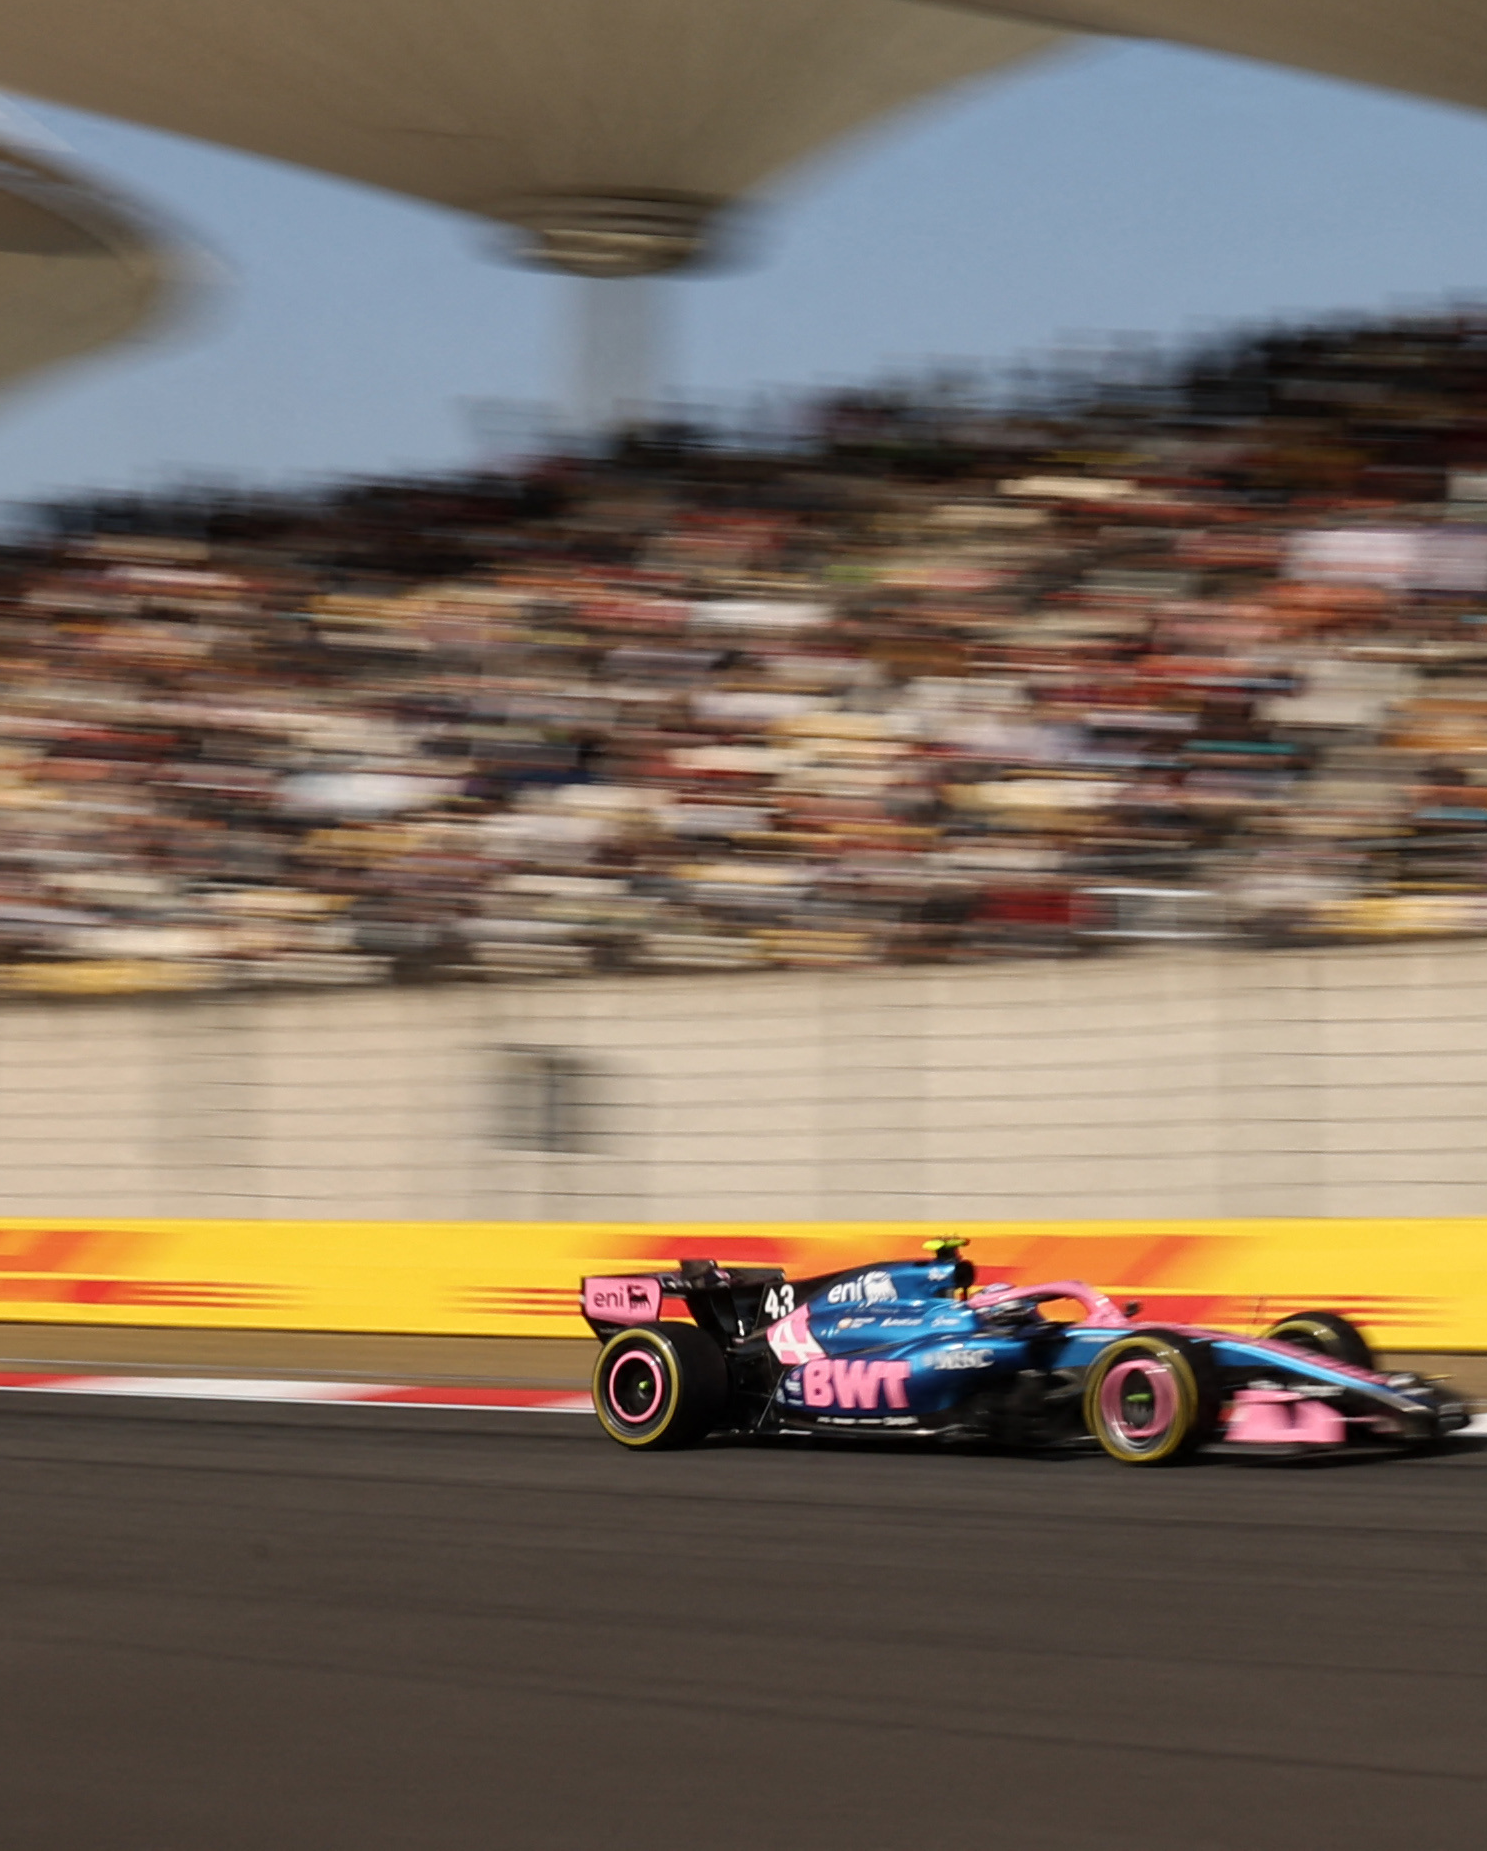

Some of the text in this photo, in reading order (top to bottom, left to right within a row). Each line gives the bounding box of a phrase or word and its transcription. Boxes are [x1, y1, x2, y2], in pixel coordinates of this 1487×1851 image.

[593, 1286, 625, 1309] eni
[764, 1283, 795, 1320] 43
[828, 1274, 864, 1304] eni
[802, 1358, 912, 1410] BWT
